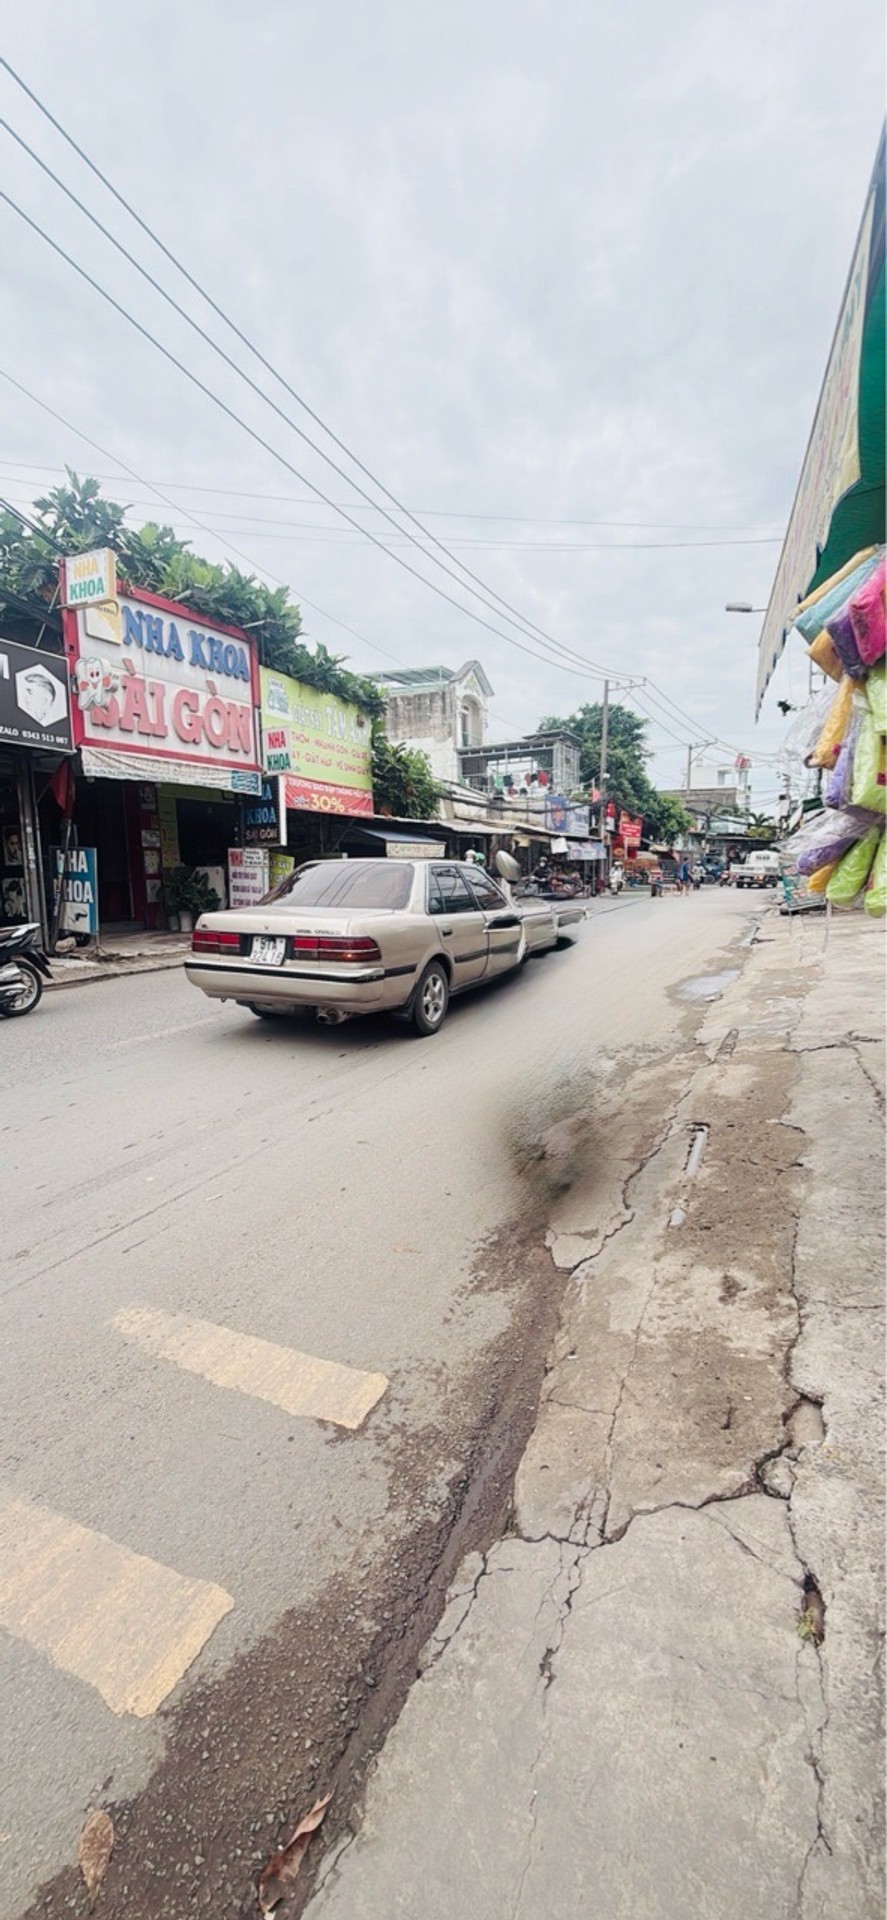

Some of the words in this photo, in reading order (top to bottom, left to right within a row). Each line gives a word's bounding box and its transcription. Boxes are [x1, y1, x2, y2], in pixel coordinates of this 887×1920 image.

[73, 556, 98, 578] NHA
[69, 576, 105, 601] KHOA
[121, 605, 184, 661] NHA
[189, 630, 250, 683] KHOA
[173, 680, 250, 753] GÒN
[268, 731, 286, 749] NHA
[267, 752, 291, 771] KHOA
[310, 793, 345, 813] 30%
